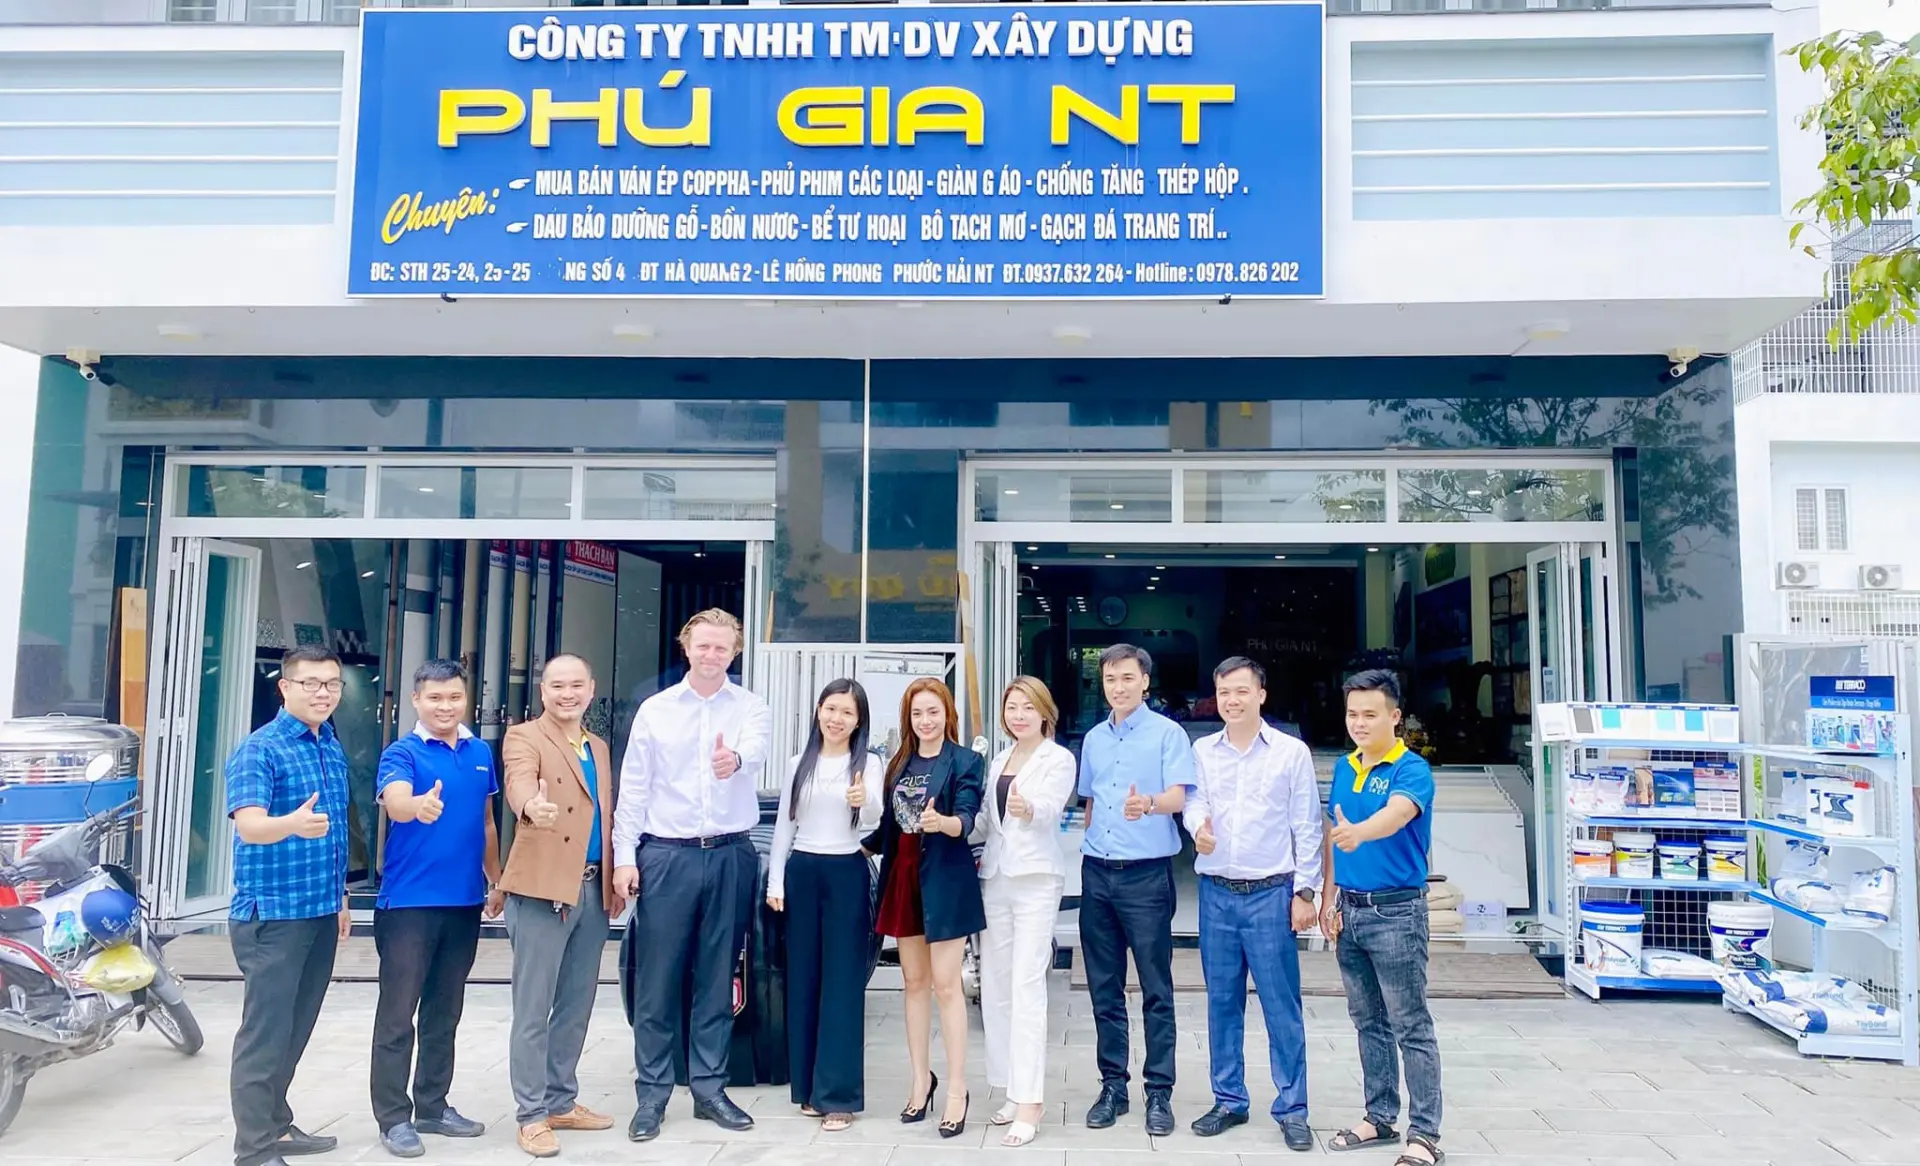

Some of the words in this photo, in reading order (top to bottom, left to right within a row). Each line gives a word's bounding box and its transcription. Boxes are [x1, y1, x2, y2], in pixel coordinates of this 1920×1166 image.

[508, 16, 625, 60] CÔNG
[635, 23, 688, 58] TY
[697, 22, 814, 57] TNHH
[971, 11, 1057, 56] XÂY
[1067, 16, 1193, 64] DỰNG
[437, 69, 712, 147] PHÚ
[776, 85, 985, 146] GIA
[1050, 83, 1236, 145] NT
[535, 170, 573, 196] MUA
[578, 164, 614, 195] BÁN
[619, 165, 652, 195] VÁN
[656, 164, 679, 195] ÉP
[799, 170, 843, 196] PHIM
[848, 164, 882, 196] CÁC
[1101, 163, 1144, 195] TĂNG
[1157, 163, 1200, 194] THÉP
[381, 186, 500, 244] Chuyên:
[571, 204, 606, 239] BẢO
[611, 206, 670, 240] DƯỠNG
[837, 211, 861, 241] TƯ
[867, 214, 907, 246] HOẠI
[949, 214, 992, 241] TACH
[1093, 208, 1117, 239] ĐÁ
[1123, 212, 1180, 239] TRANG
[370, 262, 395, 281] ĐC:
[399, 262, 429, 281] STH
[591, 256, 613, 281] SỐ
[615, 262, 626, 281] 4
[664, 258, 686, 282] HÀ
[784, 257, 825, 283] HỒNG
[832, 263, 882, 283] PHONG
[893, 259, 942, 283] PHƯỚC
[946, 256, 972, 283] HẢI
[974, 263, 994, 283] NT
[1271, 262, 1299, 282] 202
